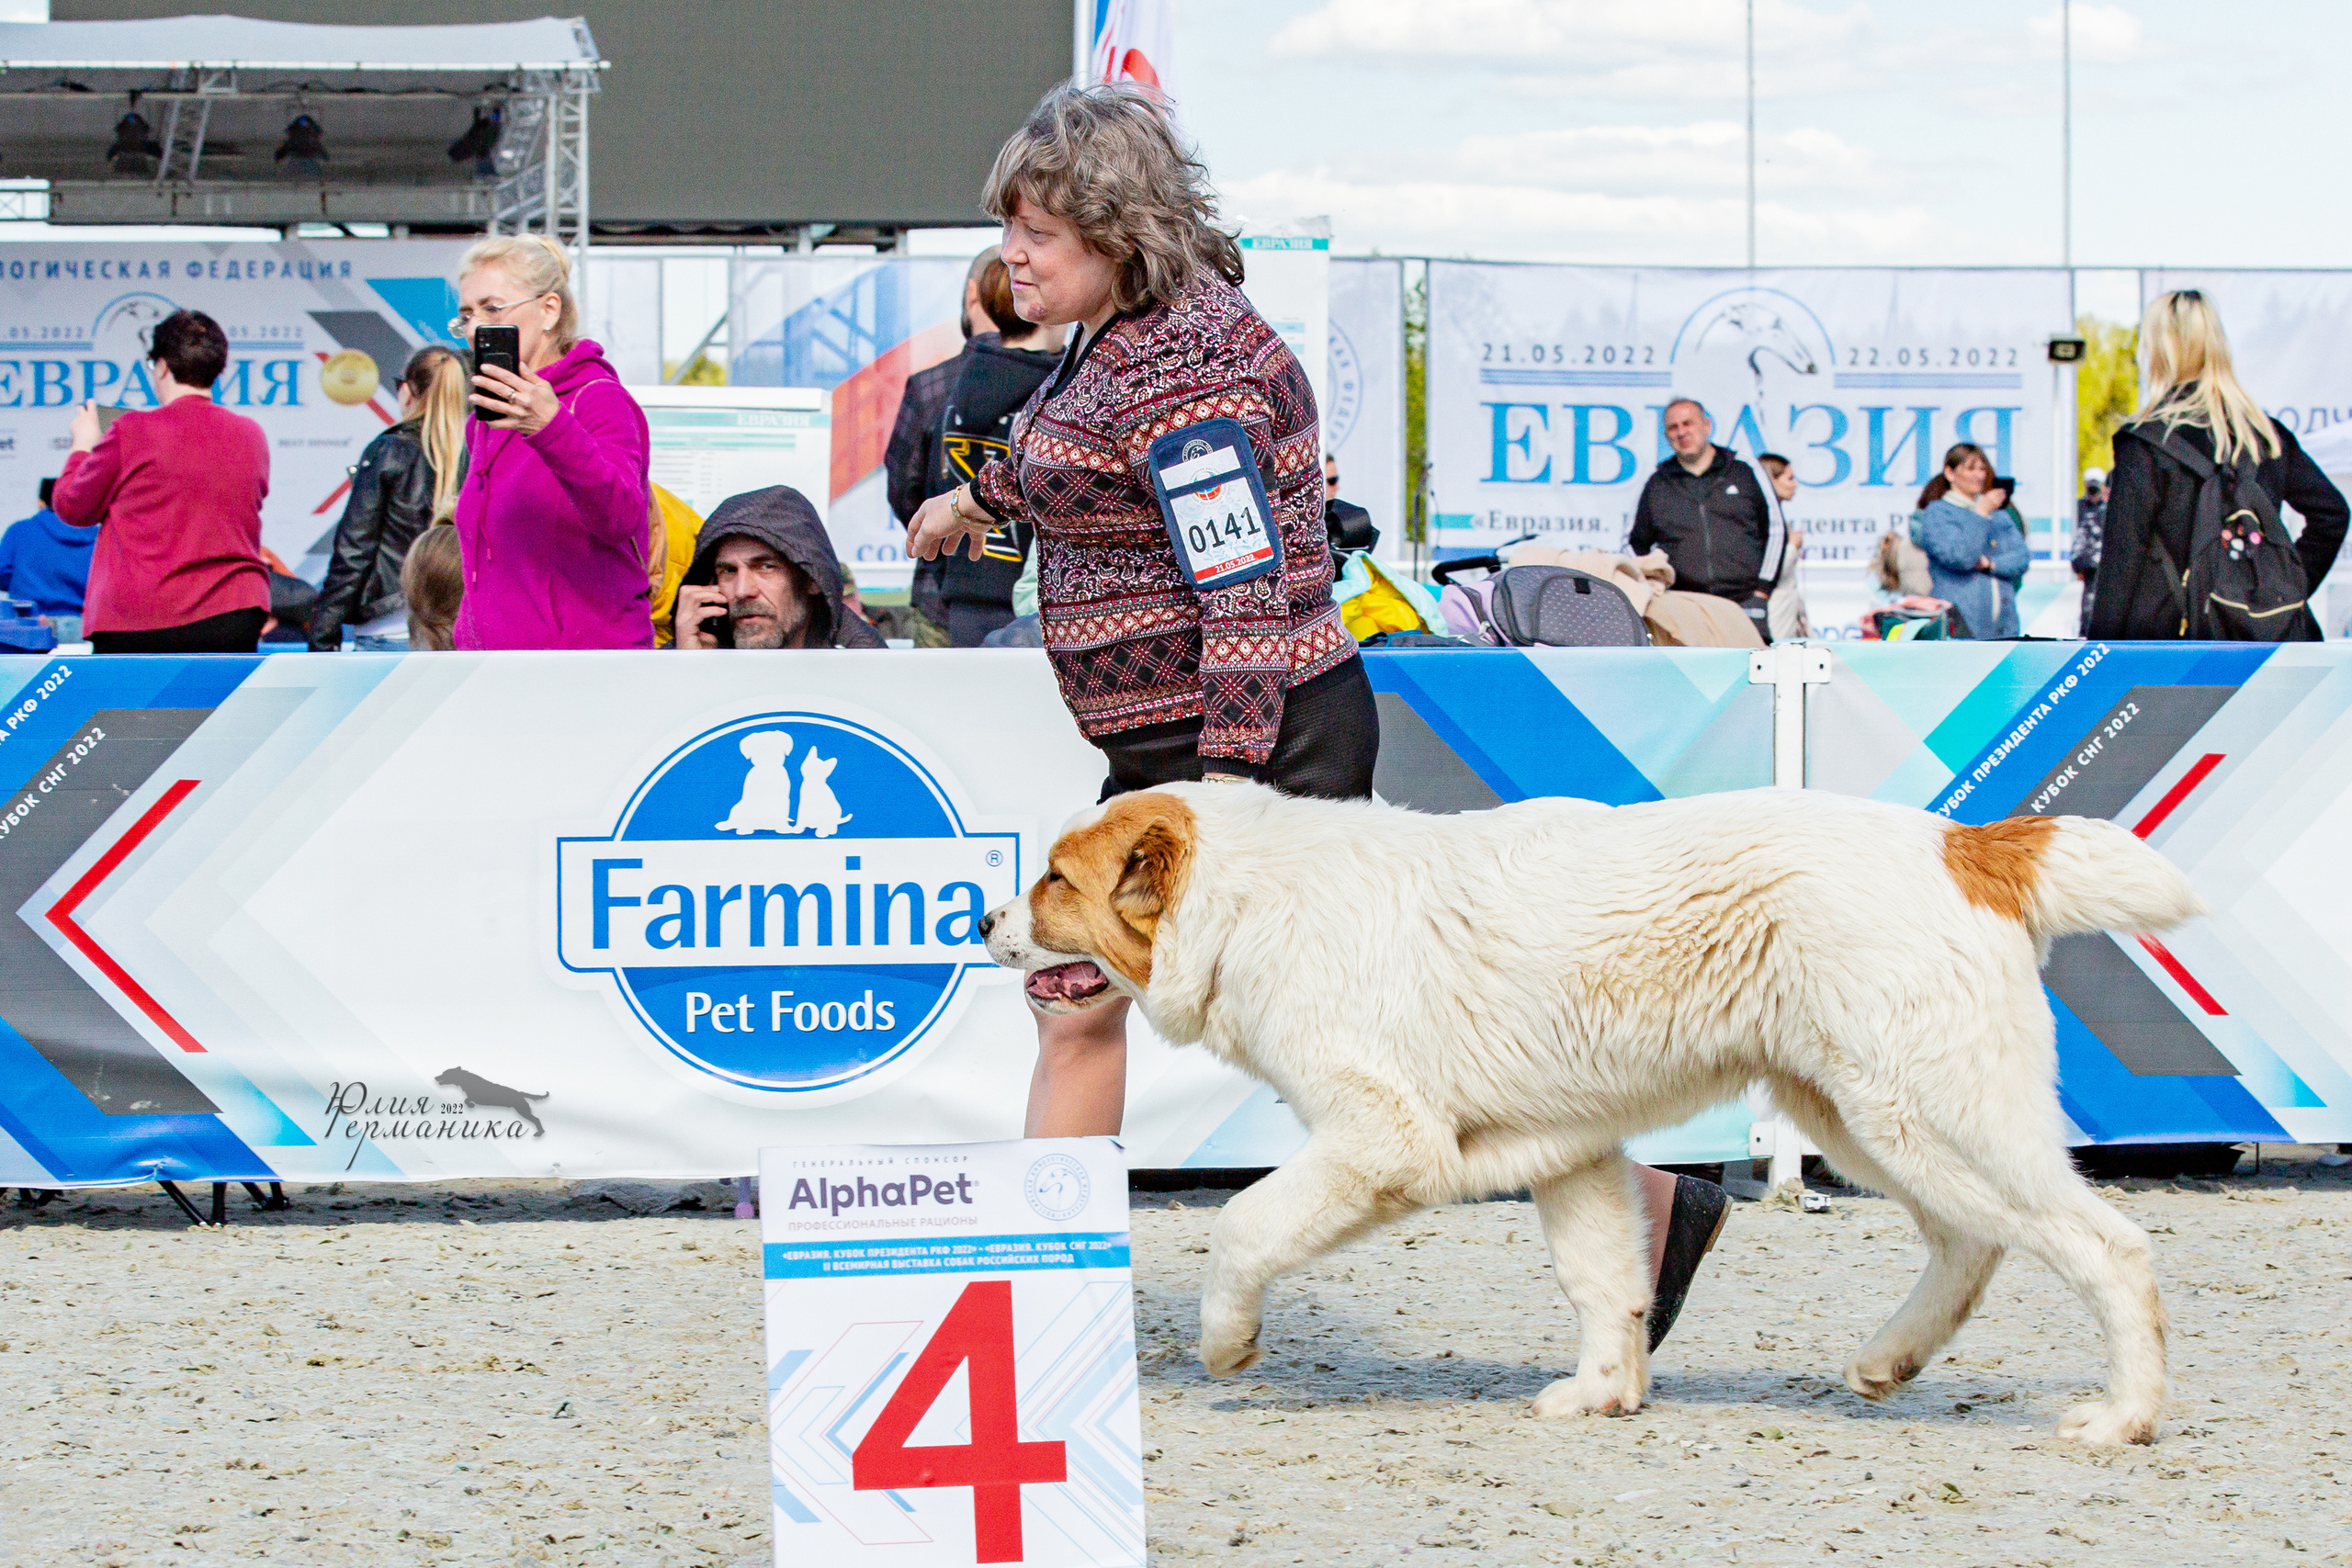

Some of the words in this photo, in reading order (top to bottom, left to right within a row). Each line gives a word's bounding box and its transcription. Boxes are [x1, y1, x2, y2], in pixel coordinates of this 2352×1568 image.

[186, 260, 352, 281] ФЕДЕРАЦИЯ
[1481, 343, 1655, 366] 21.05.2022
[1849, 347, 2018, 367] 22.05.2022
[0, 359, 305, 407] ЕВРАИЯ
[737, 413, 810, 428] ЕВРАЗИЯ
[1188, 506, 1261, 553] 0141
[1476, 511, 1611, 535] «Евразия.
[1214, 553, 1256, 573] 21.05.2022
[6, 698, 38, 729] РКФ
[36, 665, 73, 700] 2022
[1935, 780, 1975, 818] УБОК
[1972, 703, 2052, 783] ПРЕЗИДЕНТА
[2048, 674, 2078, 705] РКФ
[2076, 643, 2110, 676] 2022
[2030, 765, 2078, 813] КУБОК
[2076, 737, 2104, 766] СНГ
[2103, 702, 2140, 739] 2022
[0, 794, 40, 840] УБОК
[39, 762, 67, 793] СНГ
[66, 727, 106, 765] 2022
[592, 855, 986, 950] Farmina
[685, 991, 755, 1034] Pet
[771, 989, 897, 1032] Foods
[793, 1157, 894, 1168] ГЕНЕРАЛЬНЫЙ
[905, 1156, 968, 1164] СПОНСОР
[788, 1173, 973, 1217] AlphaPet
[788, 1218, 917, 1231] ПРОФЕССИОНАЛЬНЫЕ
[920, 1216, 978, 1227] РАЦИОНЫ
[832, 1260, 889, 1271] ВСЕМИРНАЯ
[891, 1258, 942, 1269] ВЫСТАВКА
[944, 1257, 975, 1267] СОБАК
[977, 1254, 1039, 1266] РОССИЙСКИХ
[1041, 1253, 1075, 1264] ПОРОД
[833, 1248, 865, 1258] КУБОК
[867, 1247, 928, 1258] ПРЕЗИДЕНТА
[930, 1246, 951, 1255] РКФ
[1035, 1242, 1067, 1251] КУБОК
[1069, 1241, 1087, 1251] СНГ
[852, 1280, 1069, 1564] 4
